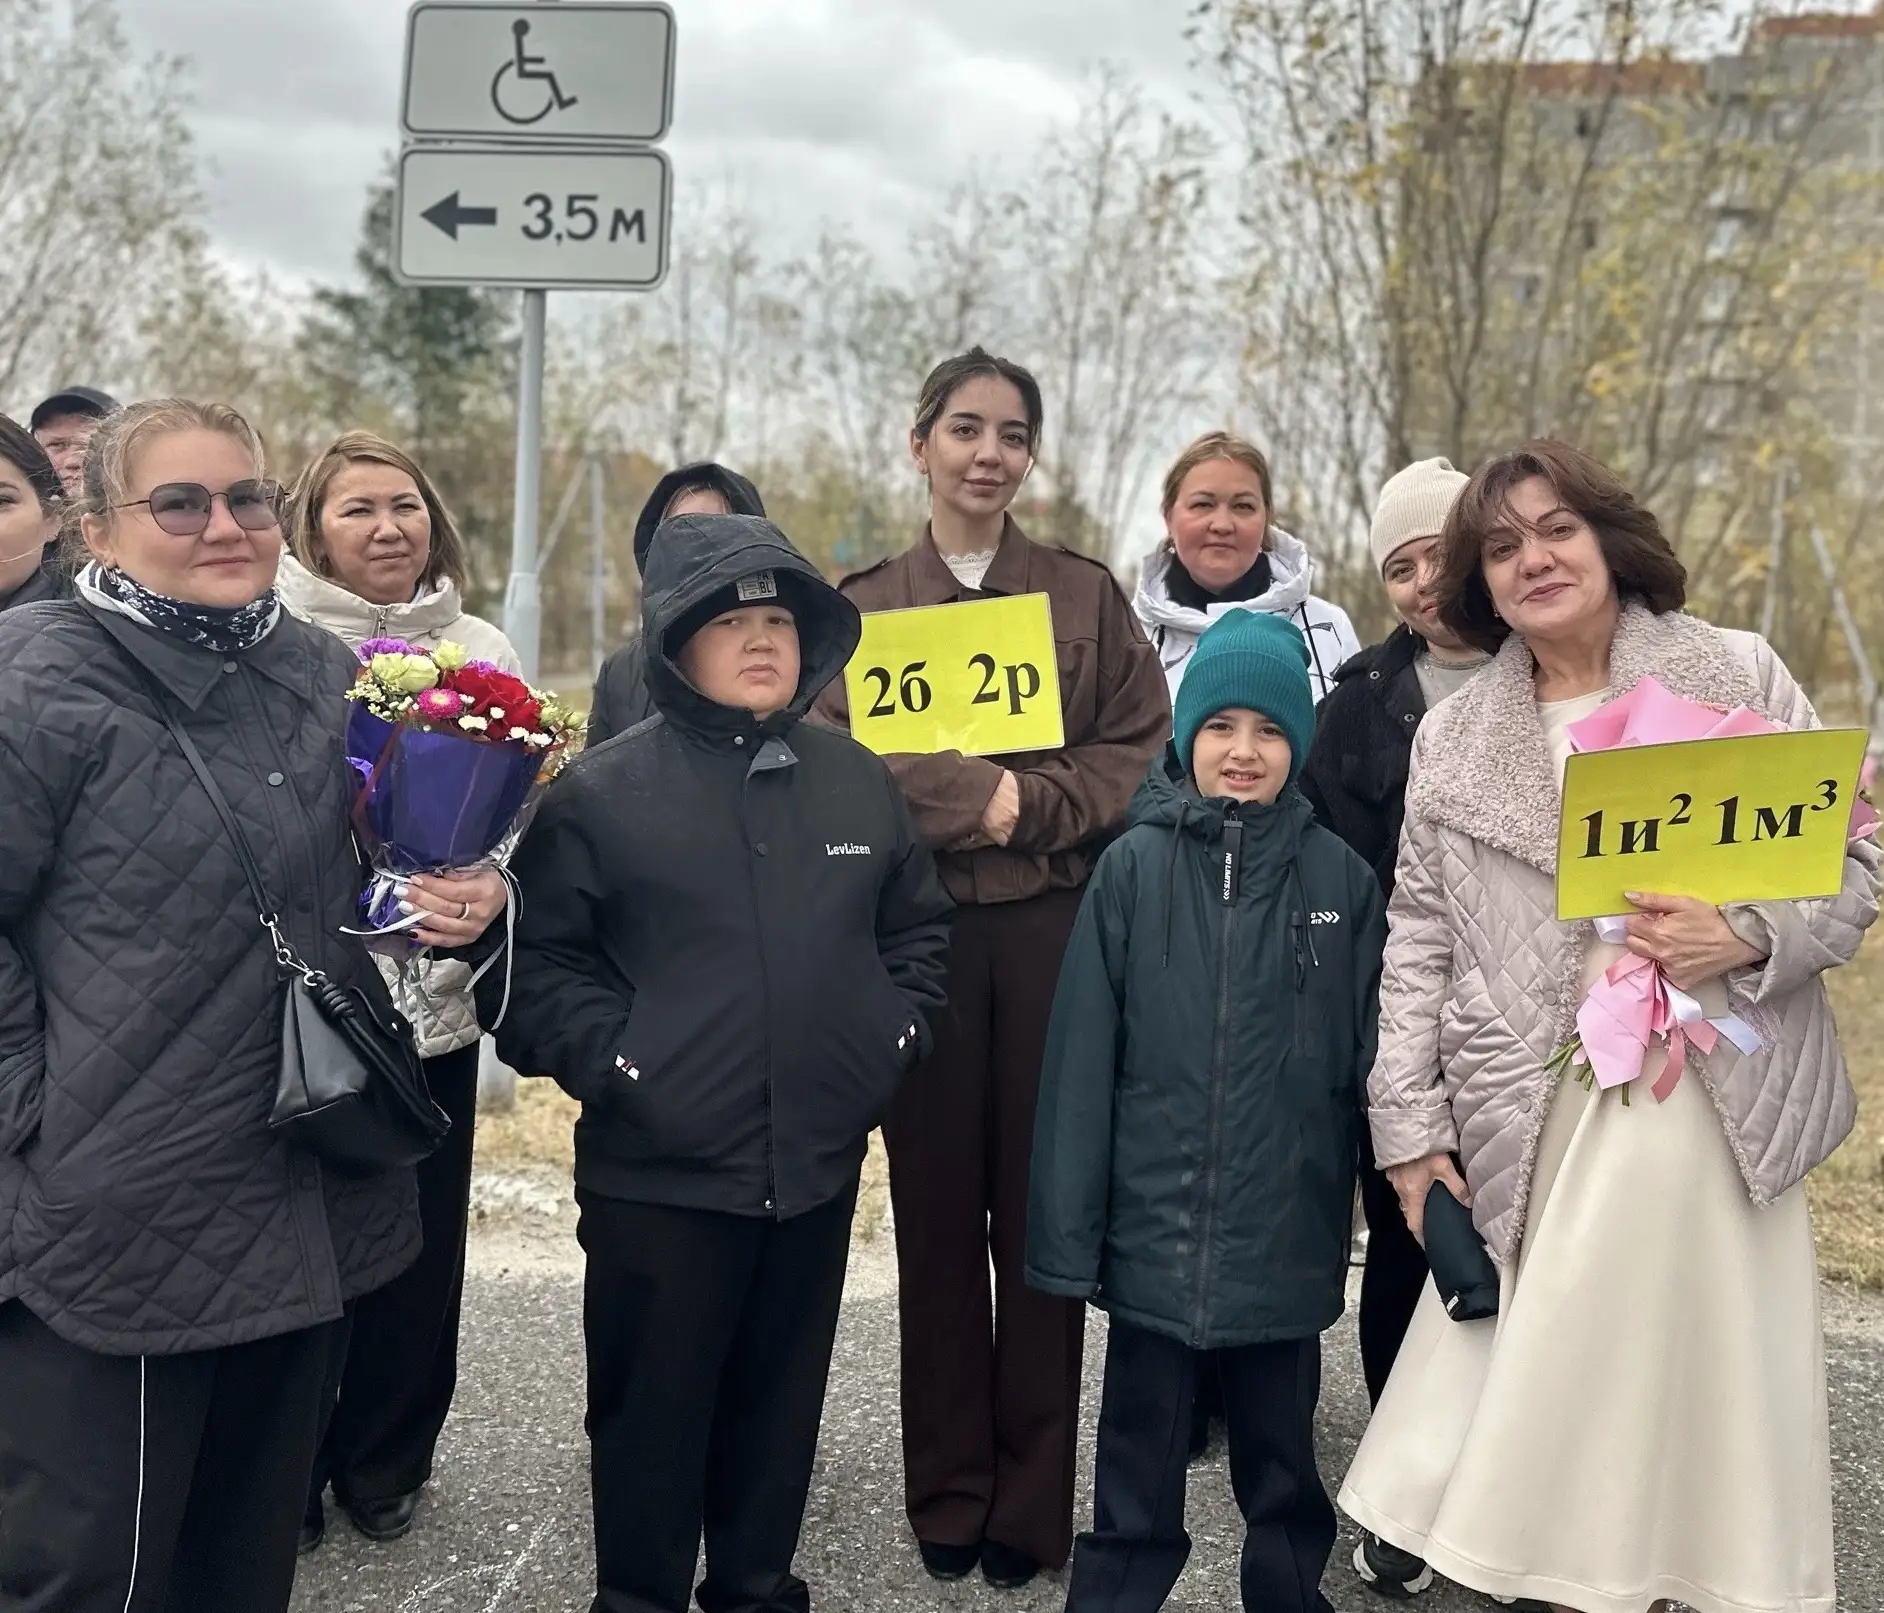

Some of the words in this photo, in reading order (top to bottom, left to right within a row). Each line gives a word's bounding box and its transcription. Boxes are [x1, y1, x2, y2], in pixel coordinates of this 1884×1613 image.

[521, 193, 599, 245] 3,5
[863, 660, 932, 718] 2б
[967, 653, 1041, 716] 2р
[826, 843, 871, 855] LevLizen
[1225, 853, 1232, 864] NO
[1223, 865, 1231, 889] LIMITS
